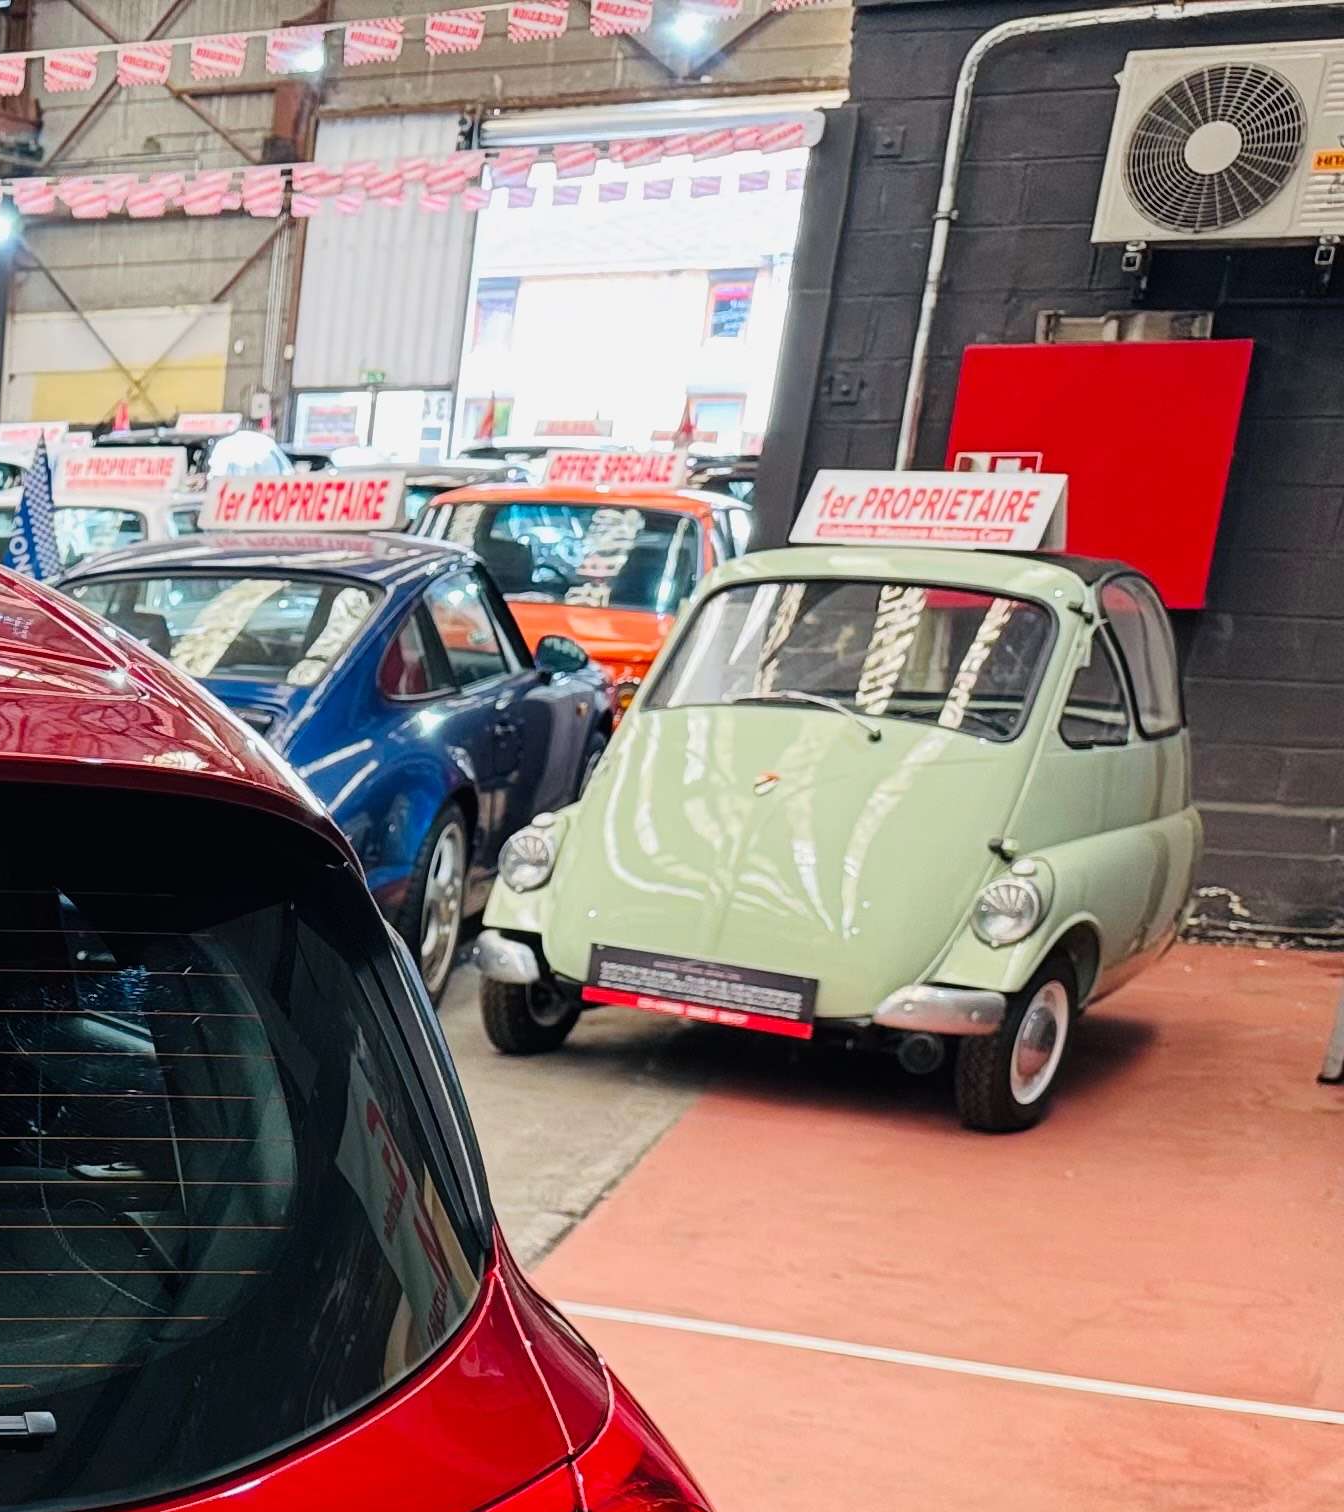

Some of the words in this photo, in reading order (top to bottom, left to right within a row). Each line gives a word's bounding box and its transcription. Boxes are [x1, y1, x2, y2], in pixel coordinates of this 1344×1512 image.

[549, 454, 600, 481] OFFRE
[601, 454, 677, 483] SPECIALE
[215, 481, 246, 522] 1er
[247, 479, 391, 522] PROPRIETAIRE
[818, 484, 856, 519] 1er
[857, 487, 1040, 524] PROPRIETAIRE
